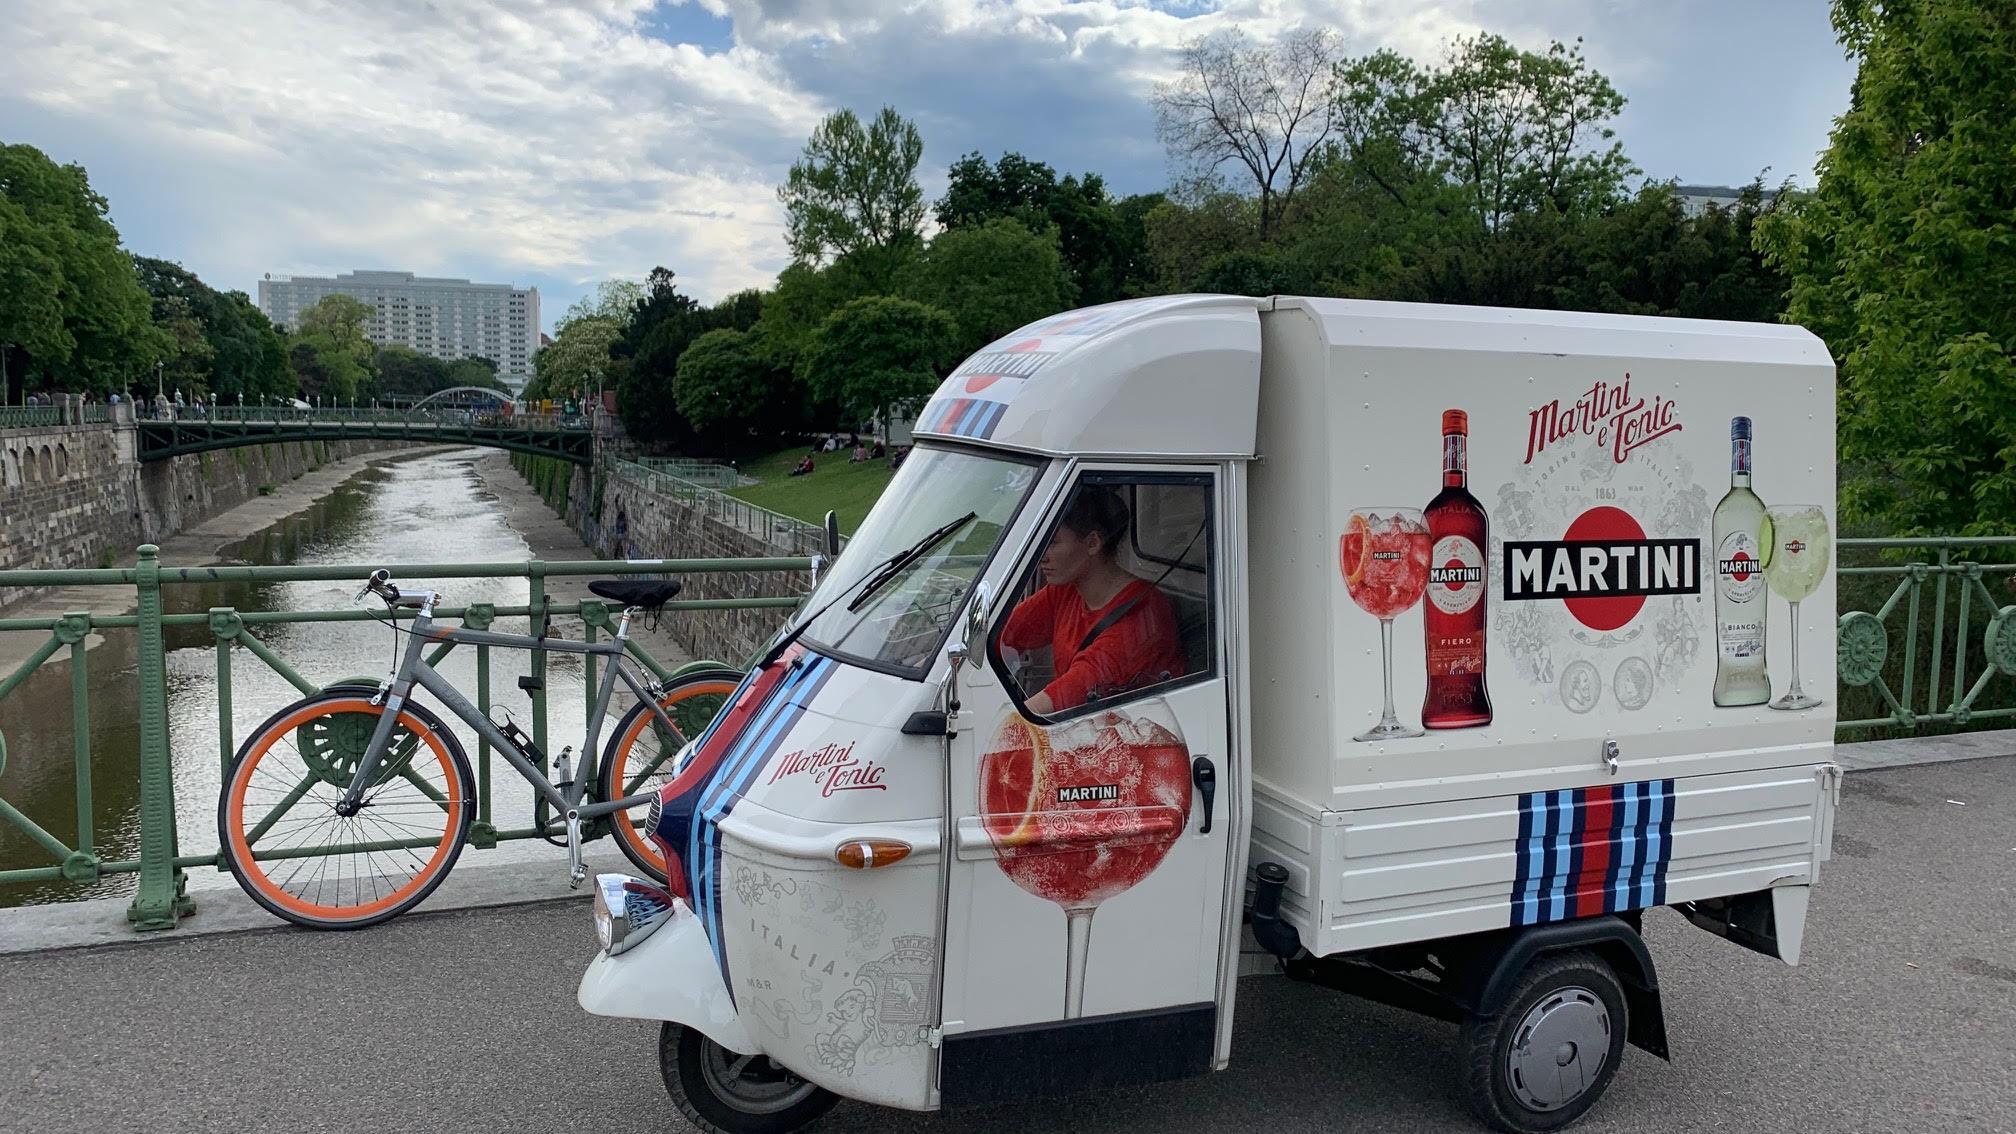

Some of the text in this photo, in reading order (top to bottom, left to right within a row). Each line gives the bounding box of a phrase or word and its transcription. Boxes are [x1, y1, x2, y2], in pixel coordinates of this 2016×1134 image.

[1524, 373, 1631, 464] Martini
[1598, 427, 1608, 447] e
[1610, 395, 1683, 464] Tonic
[1595, 487, 1616, 500] 1863
[1430, 568, 1480, 582] MARTINI
[1511, 545, 1694, 594] MARTINI
[1441, 638, 1472, 646] FIERO
[767, 741, 856, 786] Martini
[815, 758, 887, 798] e Tonic
[1060, 785, 1117, 802] MARTINI
[751, 918, 836, 976] ITALIA
[746, 977, 772, 990] M&R
